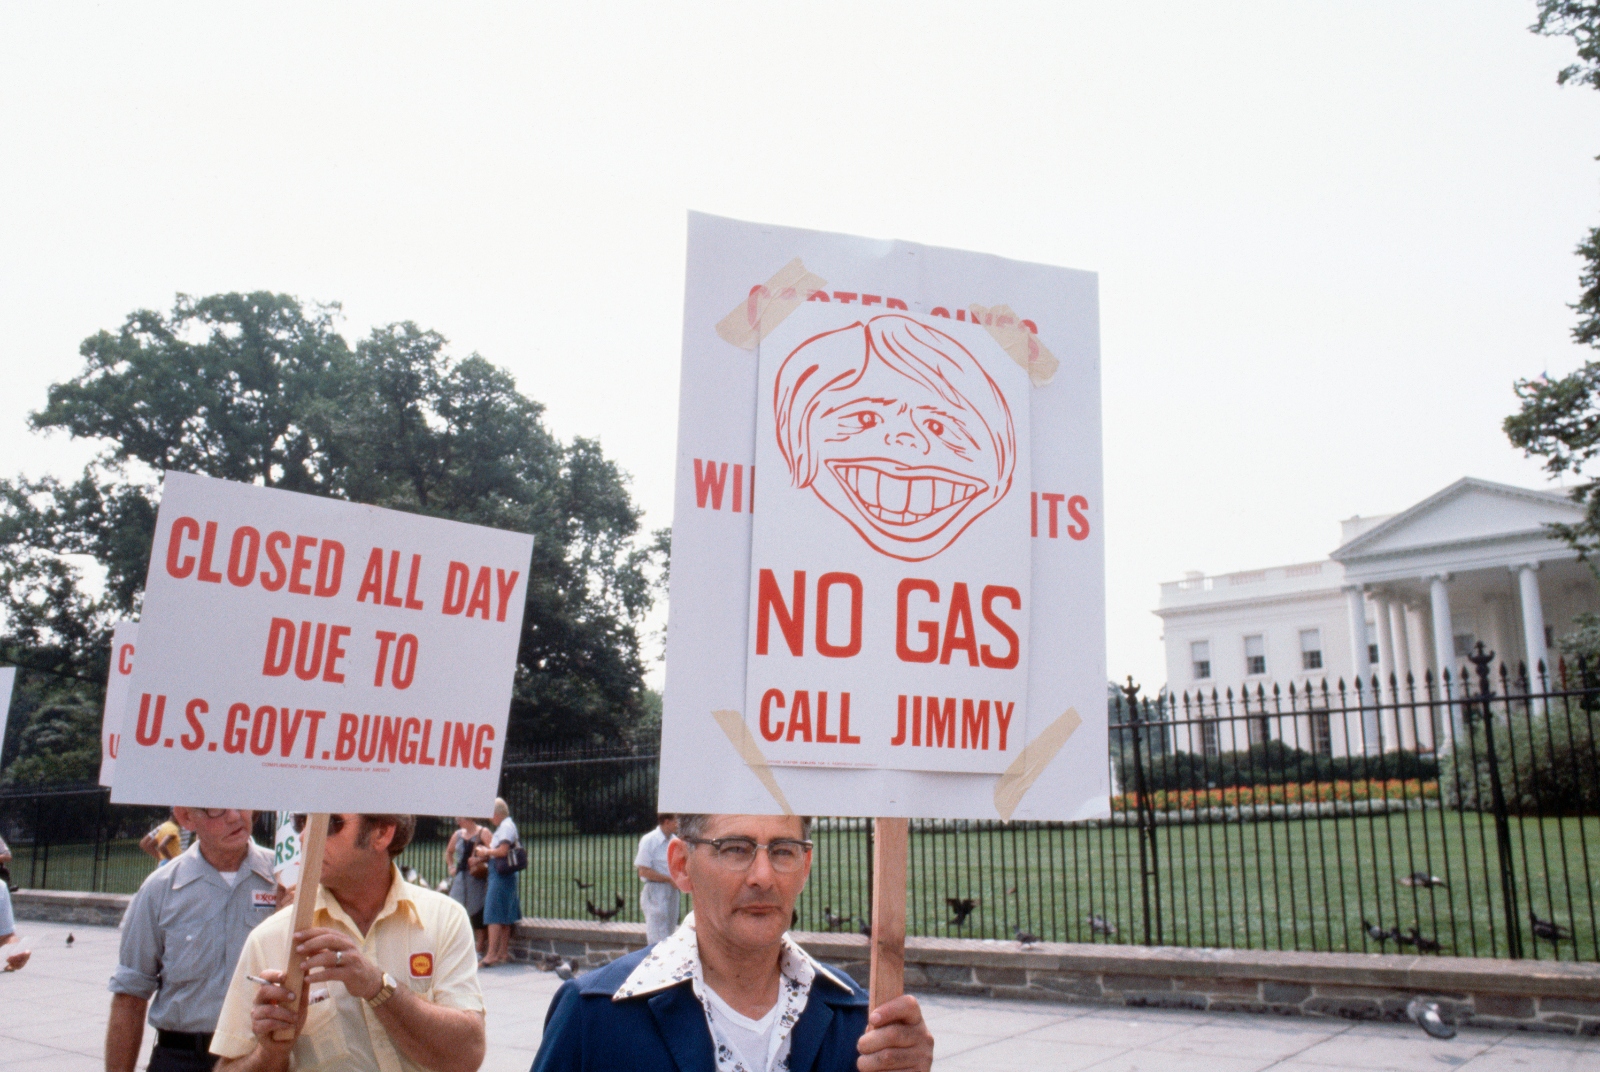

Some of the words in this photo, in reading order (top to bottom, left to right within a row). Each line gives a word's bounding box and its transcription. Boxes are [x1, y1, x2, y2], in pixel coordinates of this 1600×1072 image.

[693, 458, 755, 514] WI
[165, 516, 346, 598] CLOSED
[356, 548, 424, 611] ALL
[441, 561, 519, 623] DAY
[262, 617, 352, 684] DUE
[374, 631, 419, 691] TO
[755, 569, 864, 659] NO
[895, 578, 1022, 670] GAS
[759, 688, 861, 745] CALL
[890, 695, 1015, 751] JIMMY
